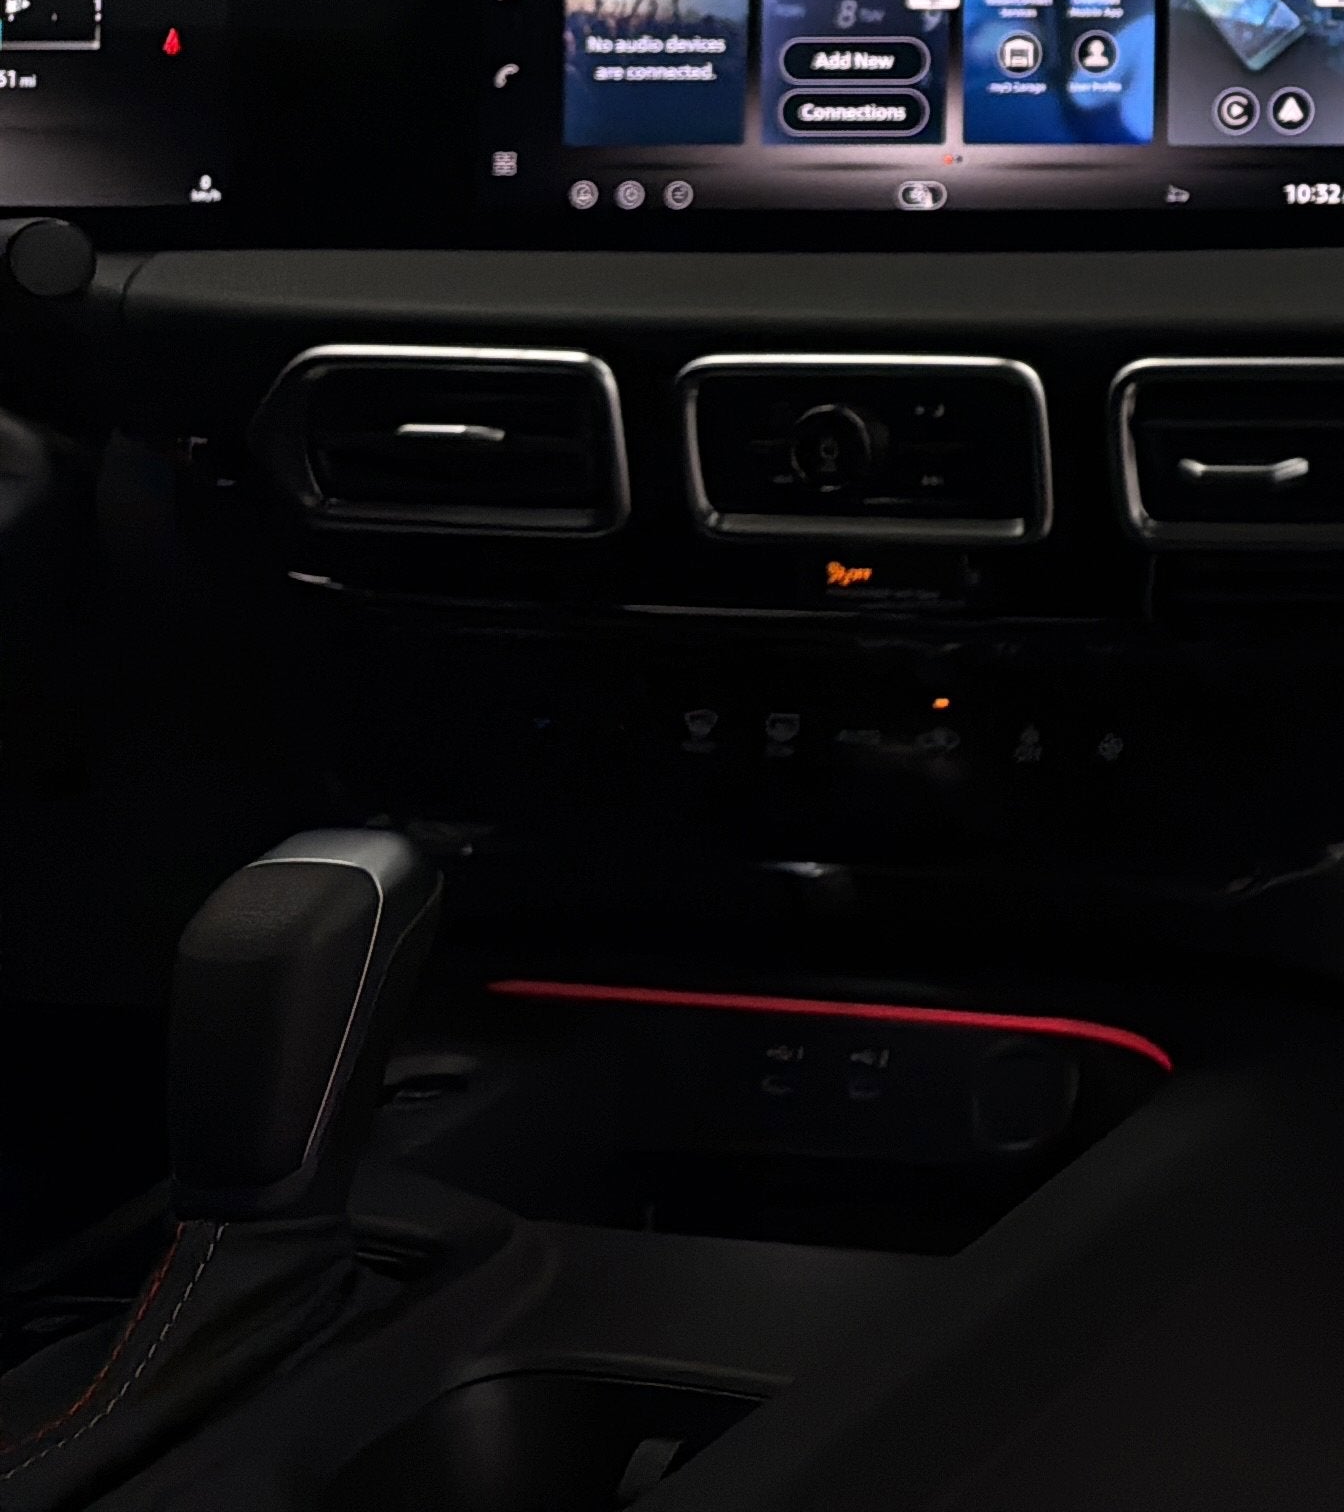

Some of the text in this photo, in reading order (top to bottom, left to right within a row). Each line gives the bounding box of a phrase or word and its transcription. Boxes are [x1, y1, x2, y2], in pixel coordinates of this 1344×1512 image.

[586, 36, 726, 55] No audio devices
[811, 50, 895, 70] Add New
[594, 63, 718, 82] are connected.
[798, 102, 908, 123] Connections
[1283, 183, 1341, 205] 10:32
